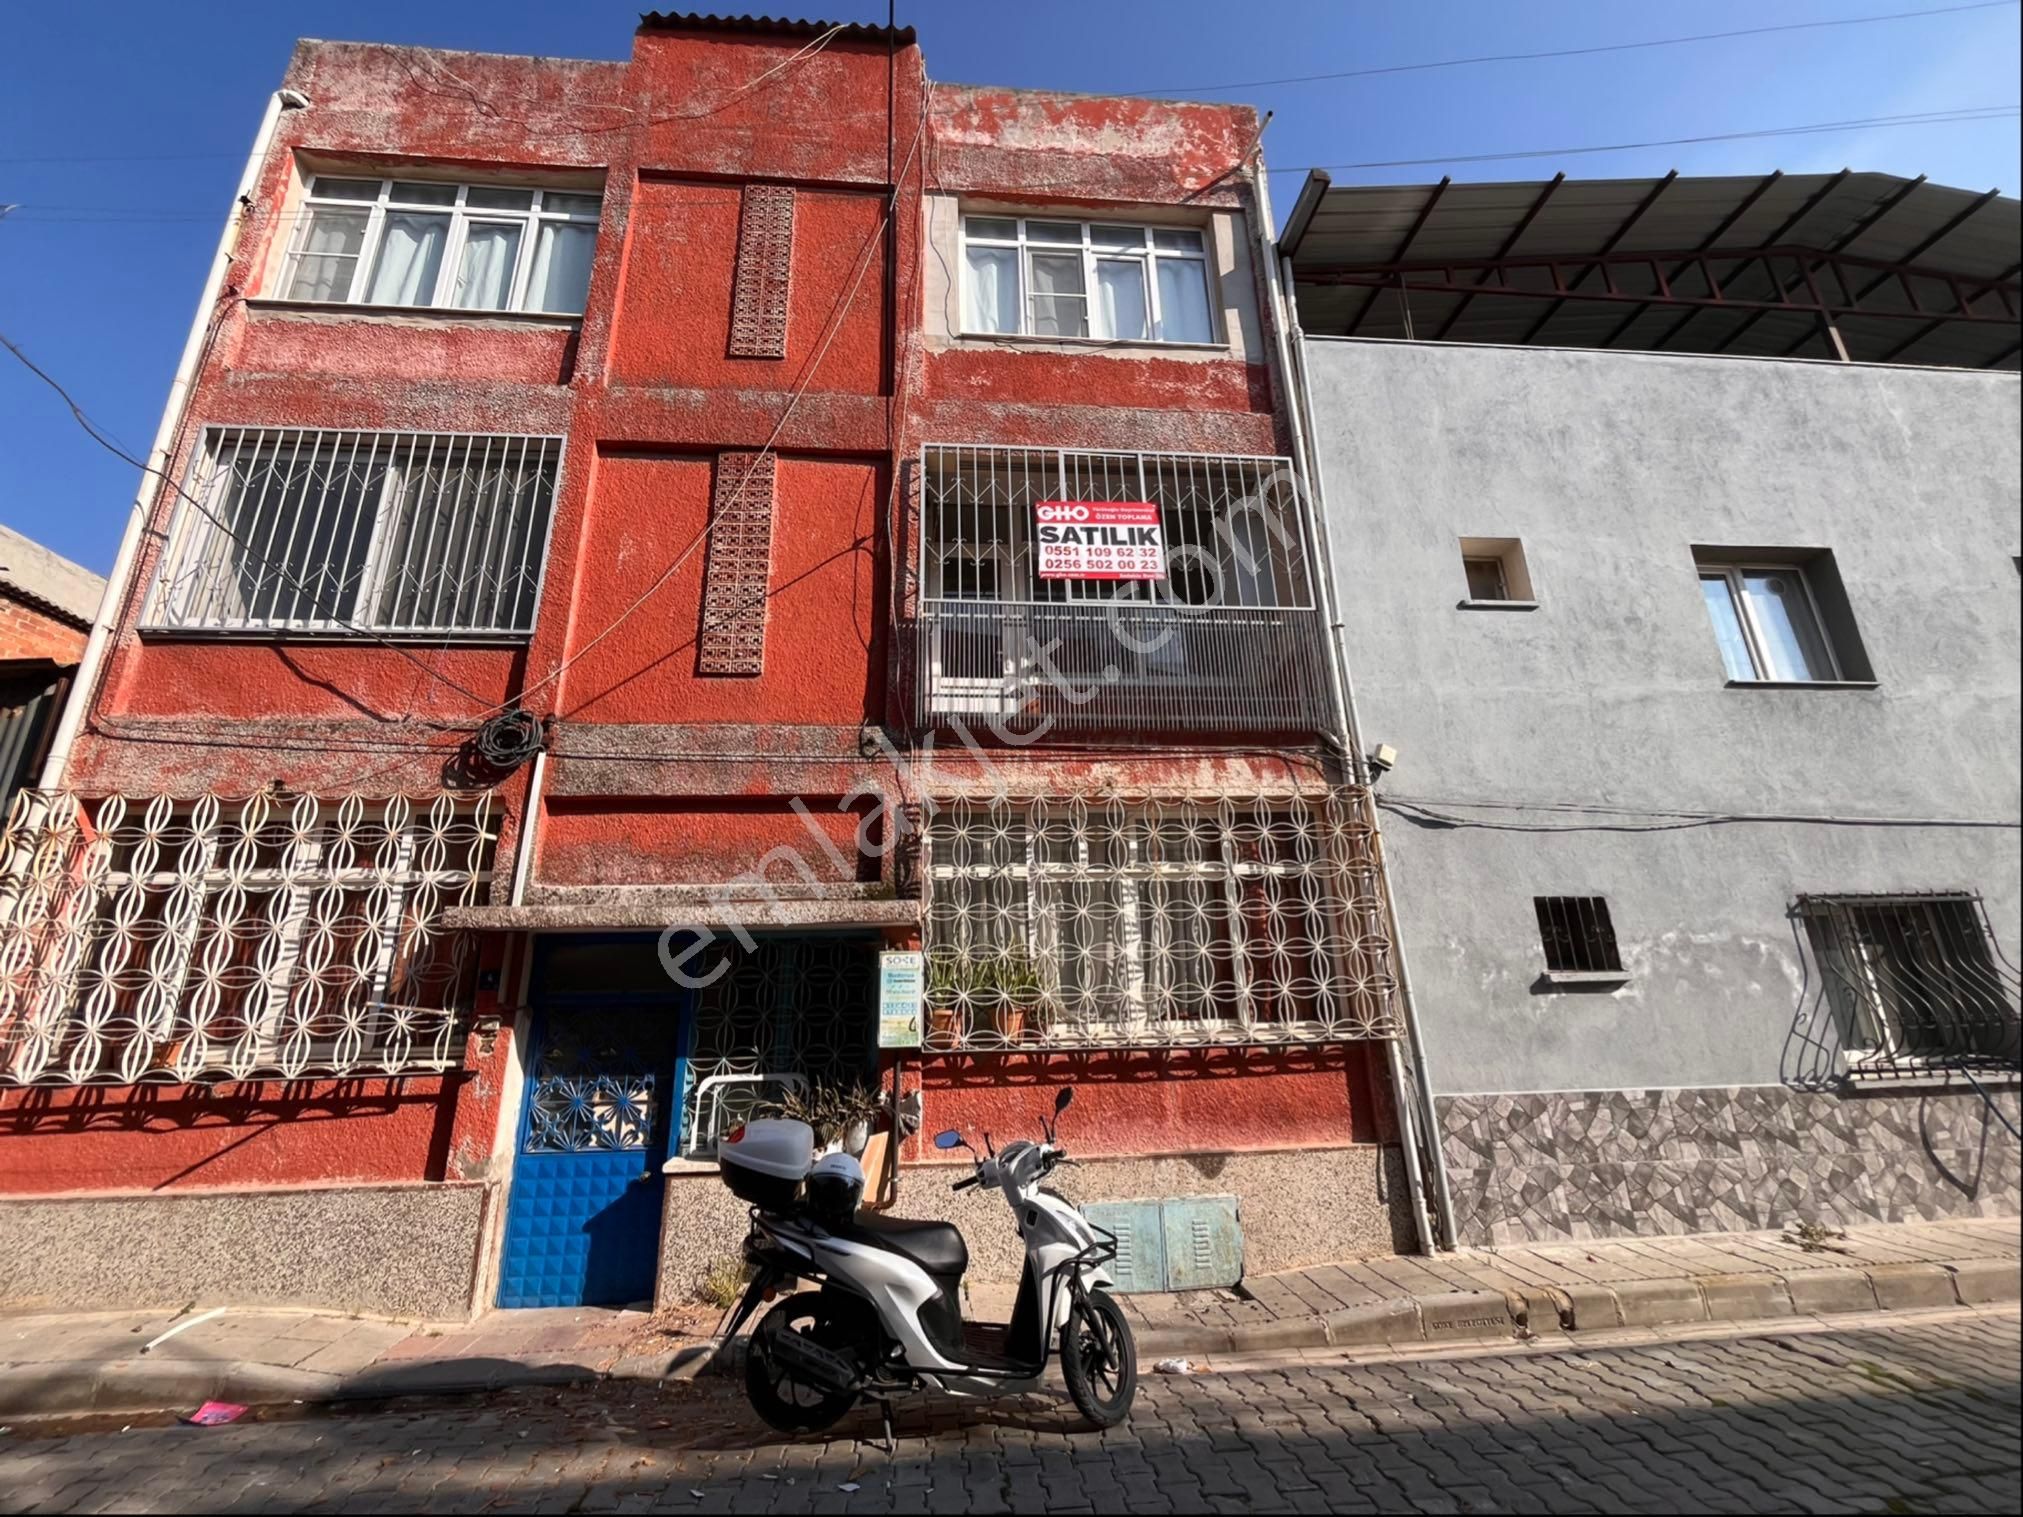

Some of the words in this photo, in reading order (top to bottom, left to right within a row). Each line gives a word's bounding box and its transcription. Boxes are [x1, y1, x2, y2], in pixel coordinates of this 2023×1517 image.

[1038, 505, 1089, 521] GHO
[1040, 526, 1159, 546] SATILIK
[1045, 545, 1080, 556] 0551
[1086, 547, 1112, 557] 109
[1117, 548, 1135, 557] 62
[1139, 548, 1157, 557] 32
[1045, 559, 1082, 569] 0256
[1086, 559, 1113, 570] 502
[1118, 560, 1136, 570] 00
[1141, 560, 1158, 570] 23
